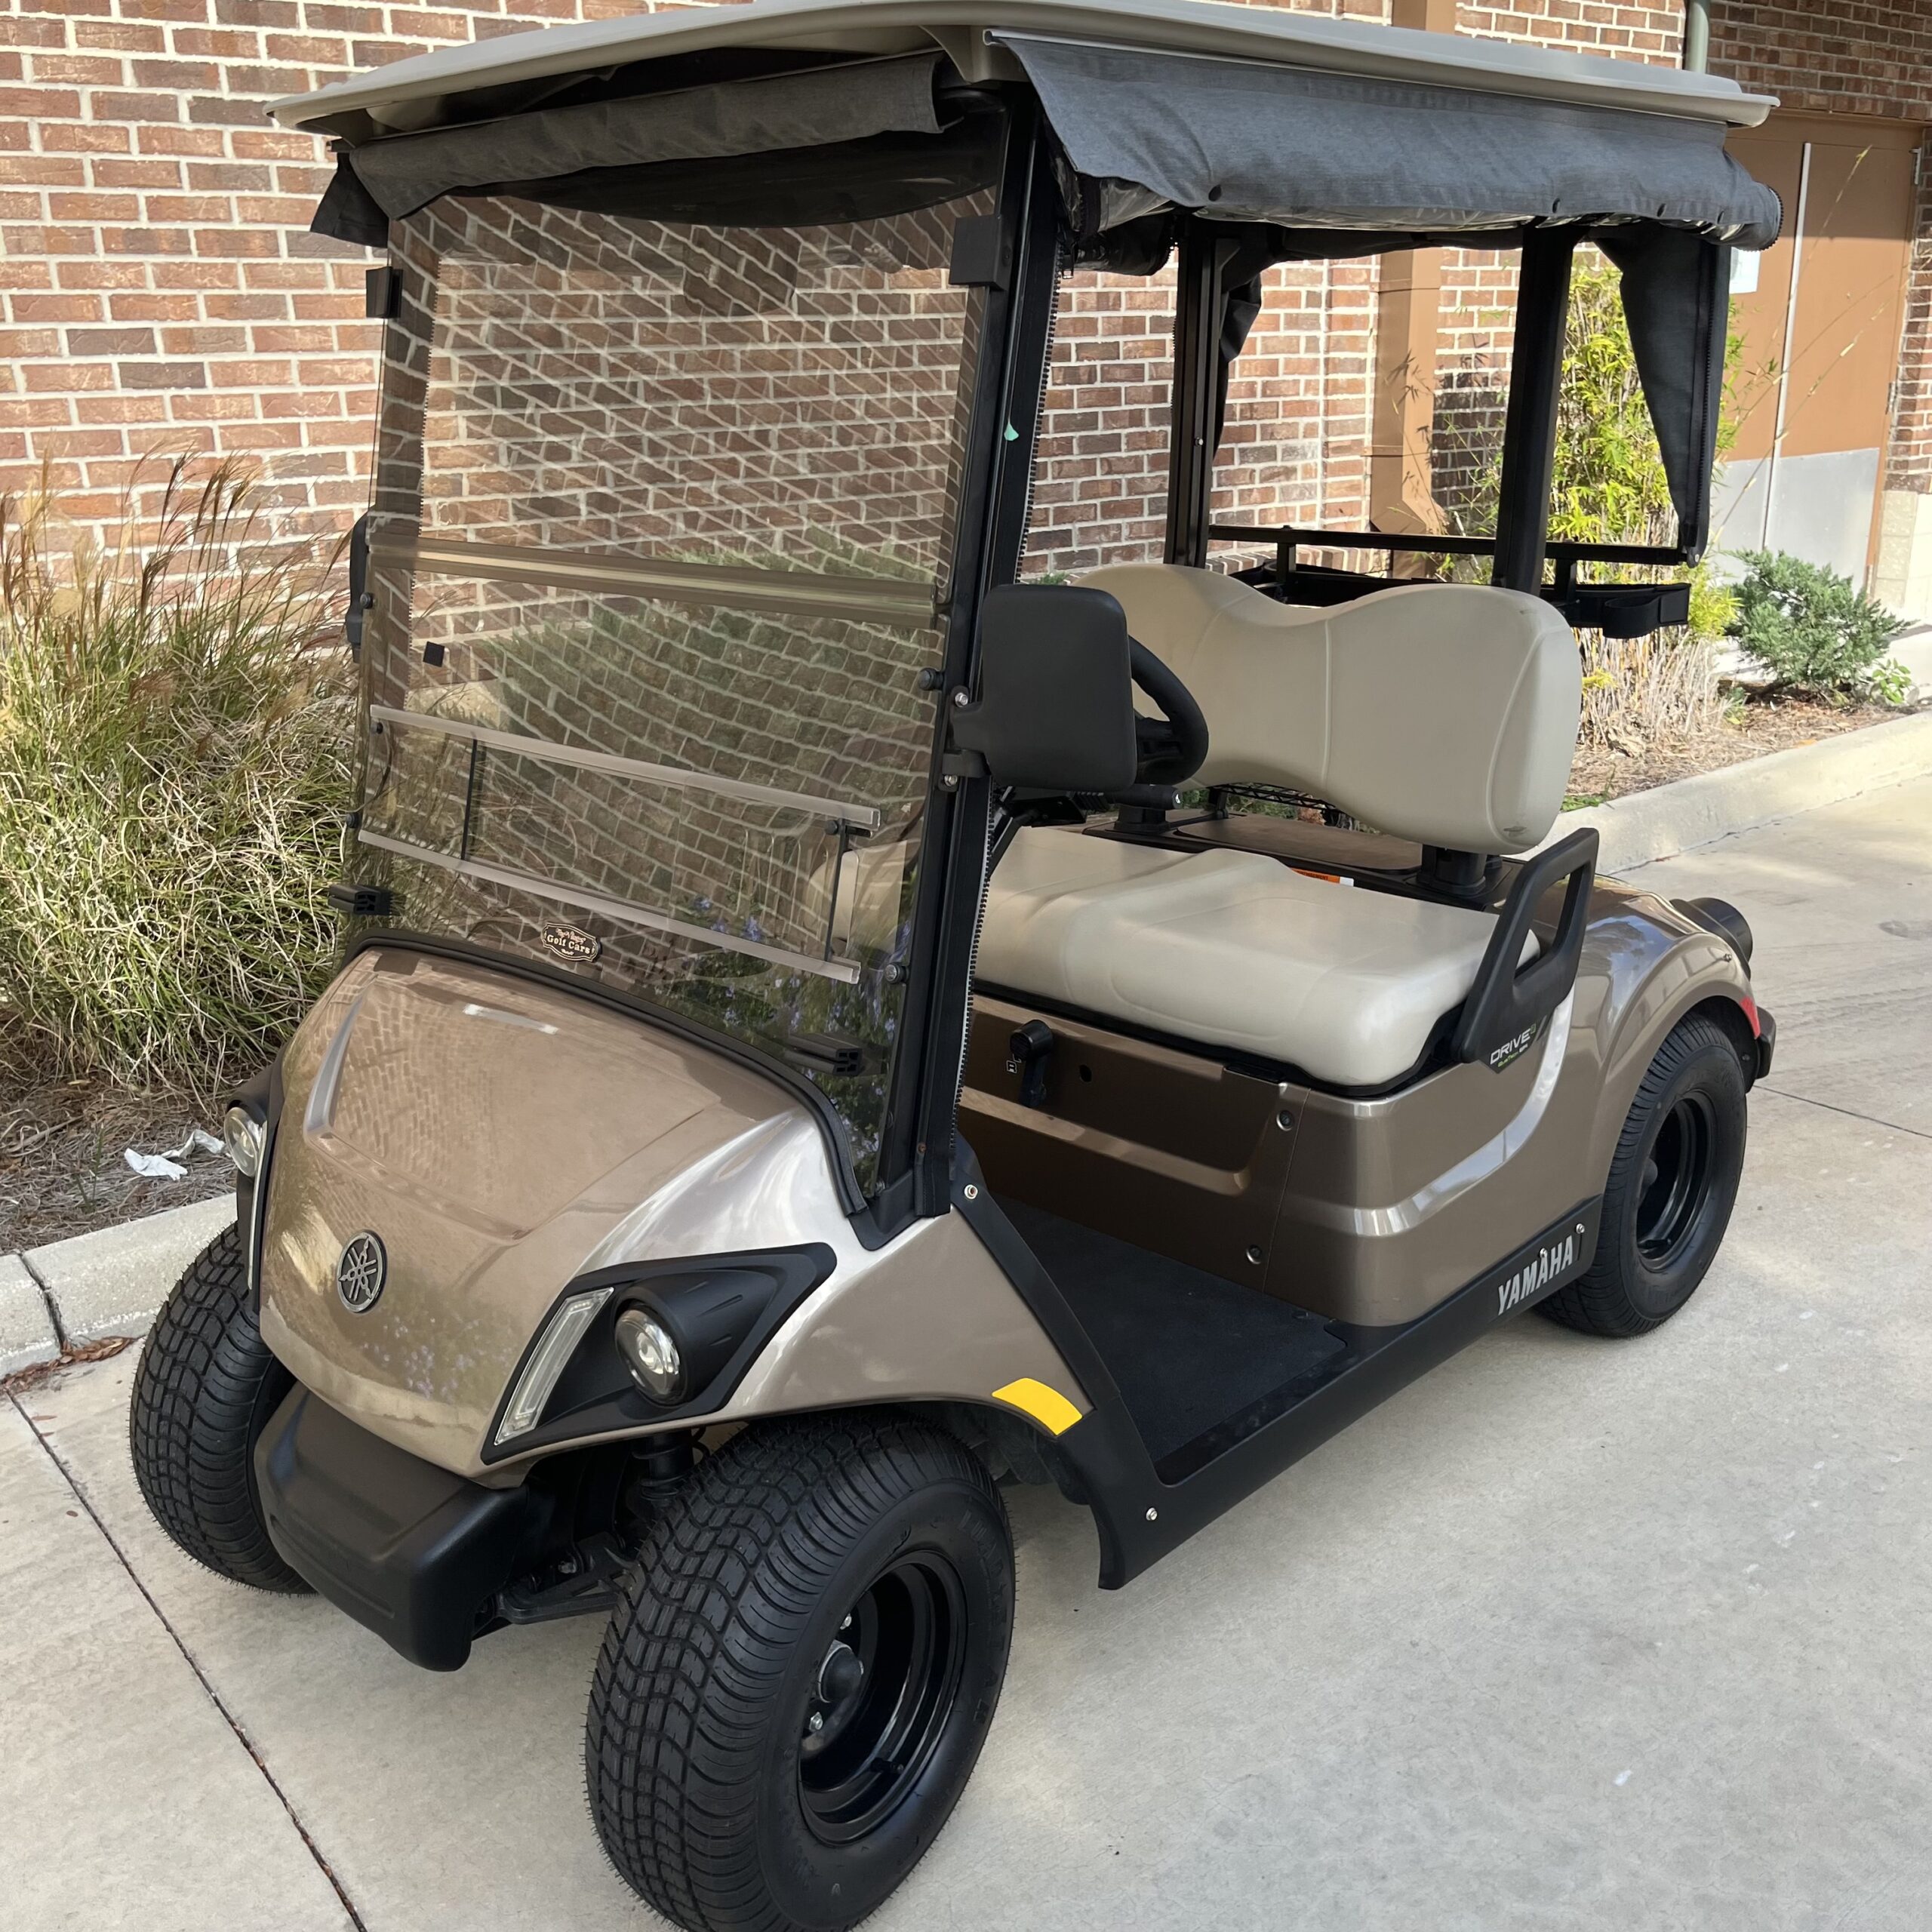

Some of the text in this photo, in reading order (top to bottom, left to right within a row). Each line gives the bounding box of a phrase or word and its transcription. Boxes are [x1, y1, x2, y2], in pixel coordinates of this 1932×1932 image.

[546, 934, 567, 947] Golf
[568, 940, 591, 955] Cars
[1498, 1235, 1573, 1315] YAMAHA
